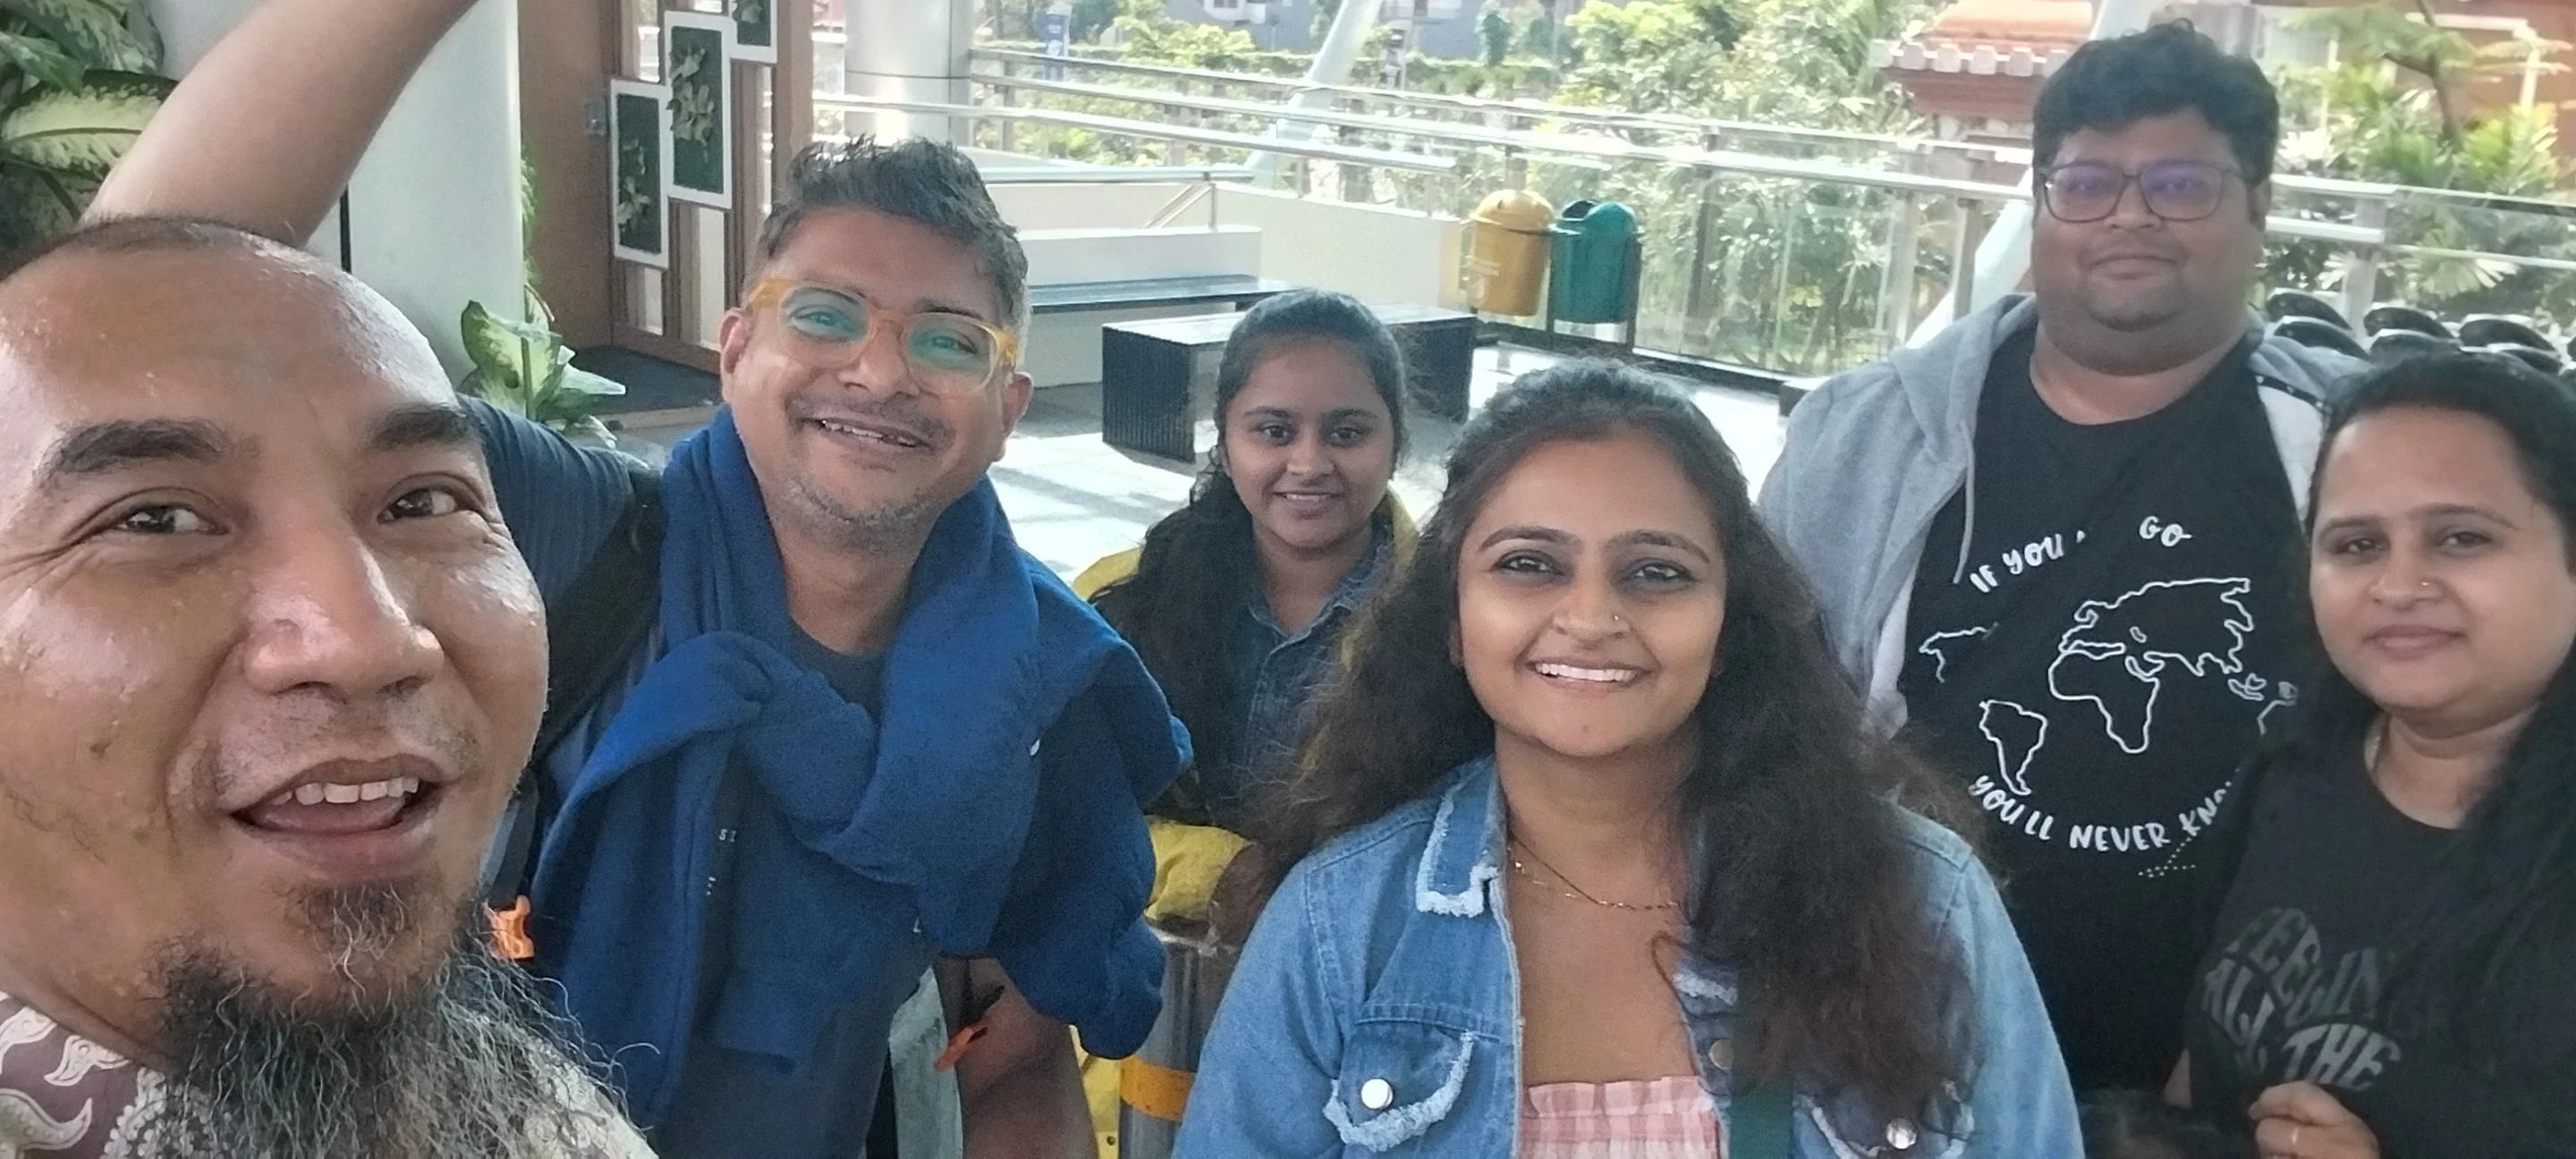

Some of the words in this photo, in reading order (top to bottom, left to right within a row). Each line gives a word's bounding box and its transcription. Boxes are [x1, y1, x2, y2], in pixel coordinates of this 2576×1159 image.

[1970, 565, 1998, 593] IF
[2003, 534, 2064, 575] YOU
[2140, 516, 2192, 547] GO
[2070, 823, 2171, 851] NEVER
[2281, 1022, 2404, 1093] THE
